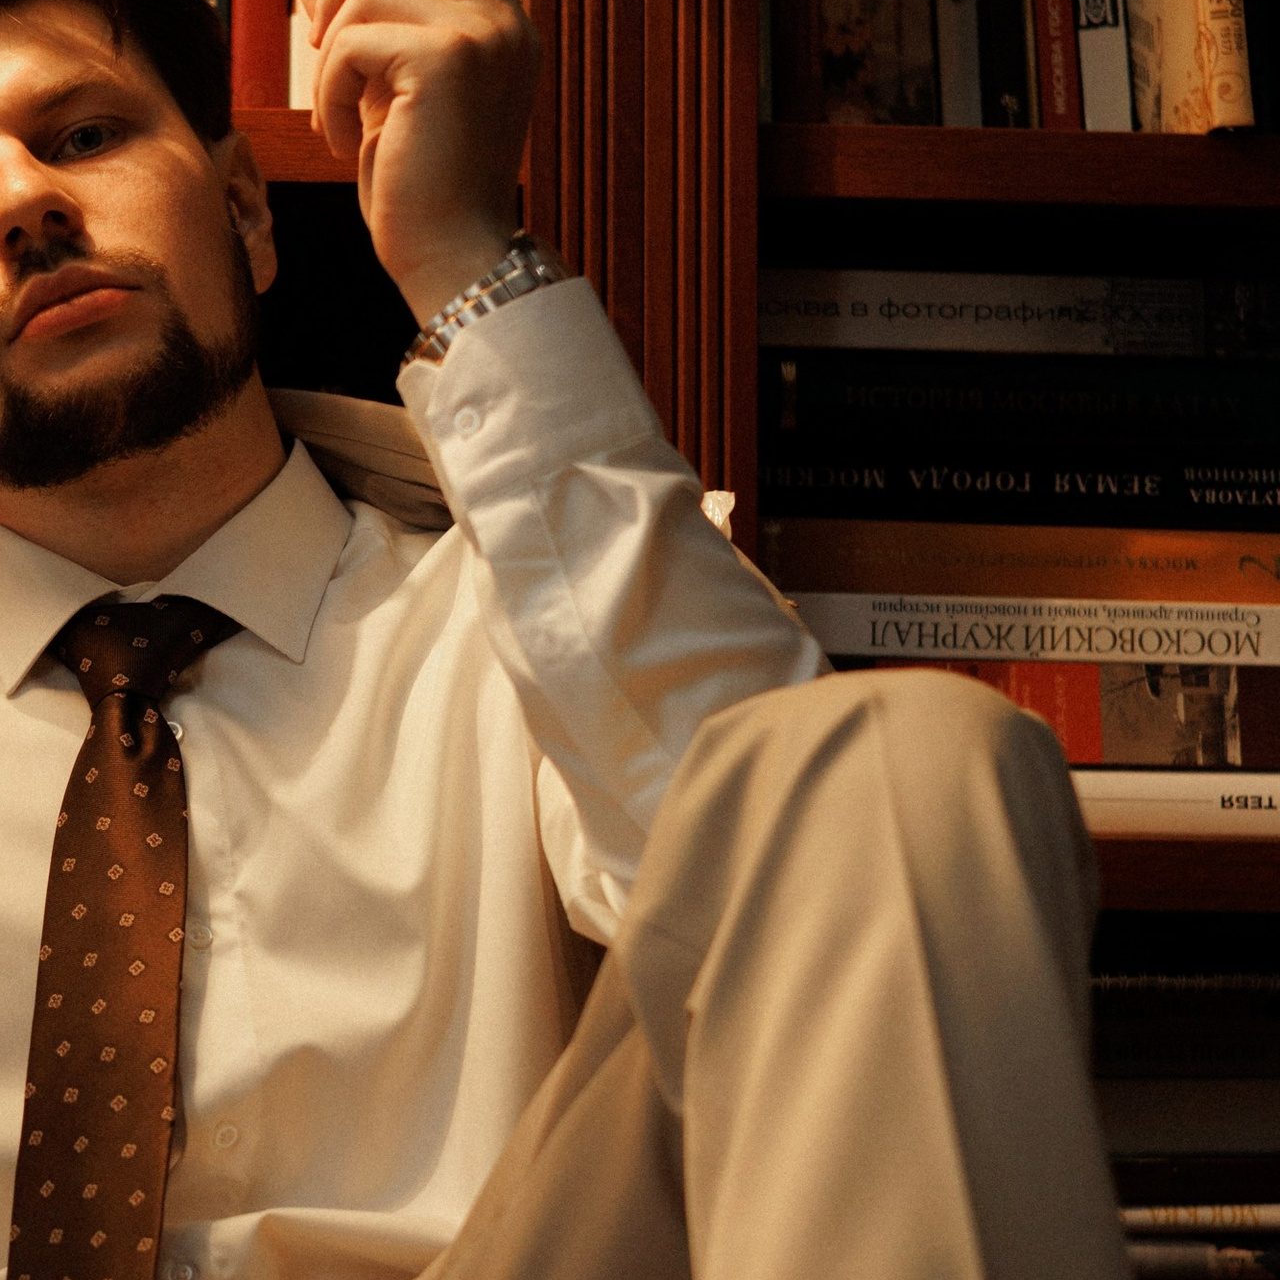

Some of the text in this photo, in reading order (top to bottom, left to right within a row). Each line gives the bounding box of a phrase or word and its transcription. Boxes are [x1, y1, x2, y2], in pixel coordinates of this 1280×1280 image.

[907, 464, 1033, 495] ГОРОДА
[1053, 470, 1162, 497] ЗЕМЛЯ
[870, 598, 933, 616] истории
[937, 602, 1028, 620] новейшей
[1047, 605, 1099, 623] новой
[1176, 605, 1263, 628] Страницы
[869, 619, 1263, 659] МОСКОВСКИЙ ЖУРНАЛ
[1220, 795, 1279, 812] ТЕБЯ
